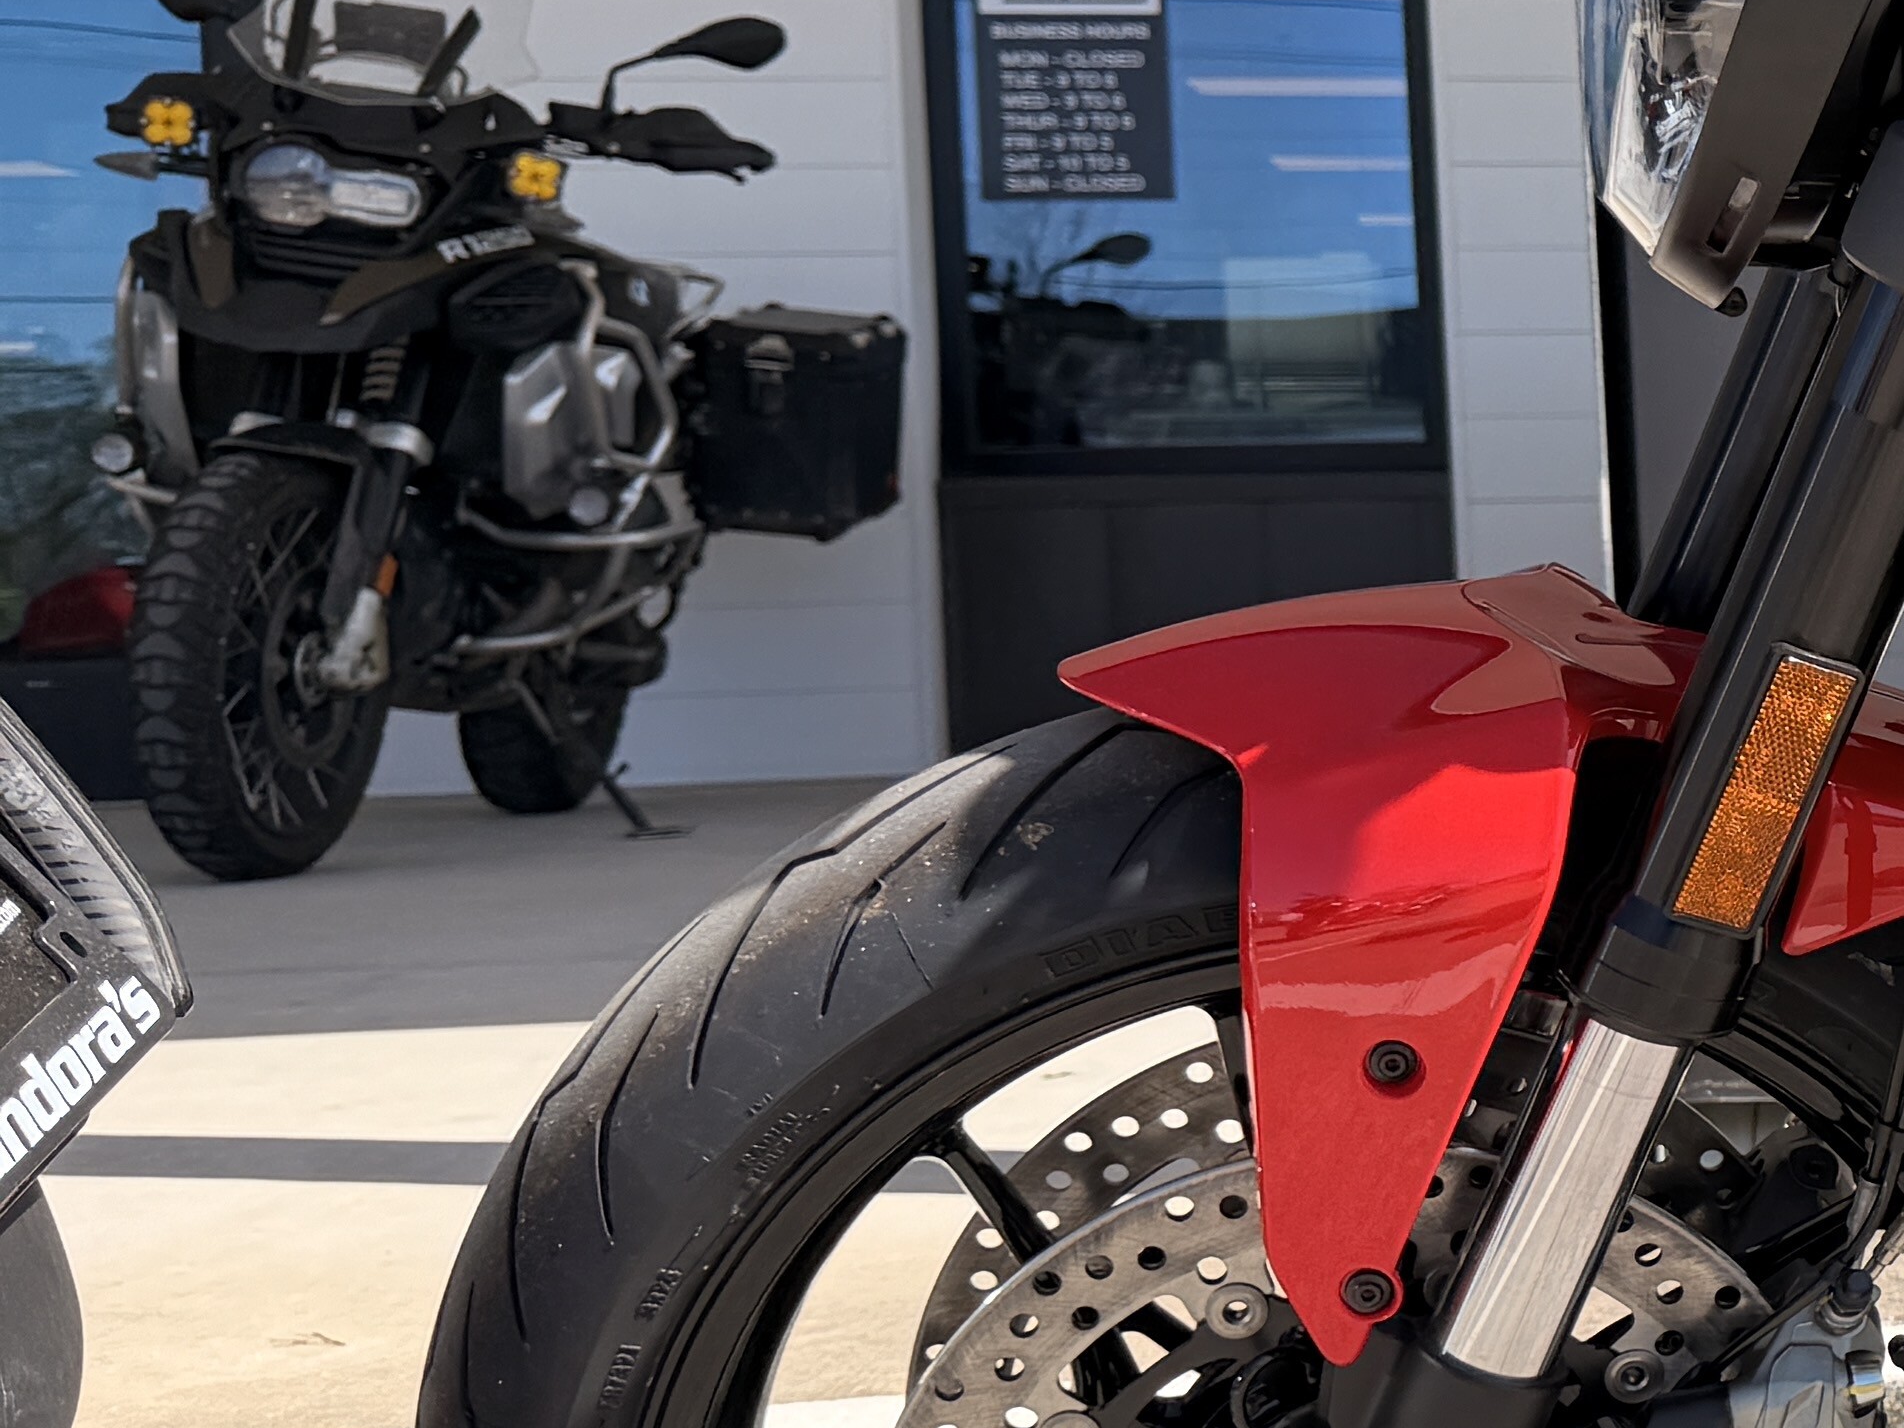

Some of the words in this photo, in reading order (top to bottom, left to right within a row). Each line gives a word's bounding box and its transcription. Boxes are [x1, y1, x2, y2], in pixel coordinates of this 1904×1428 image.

[988, 22, 1084, 40] BUSINESS
[1085, 22, 1151, 40] HOURS
[998, 50, 1049, 68] MON
[1062, 50, 1145, 68] CLOSED
[1000, 71, 1043, 89] TUE
[1000, 91, 1050, 110] WED
[1003, 153, 1041, 172] SAT
[1003, 173, 1049, 192] SUN
[1062, 173, 1146, 192] CLOSED
[0, 975, 160, 1177] ndora's
